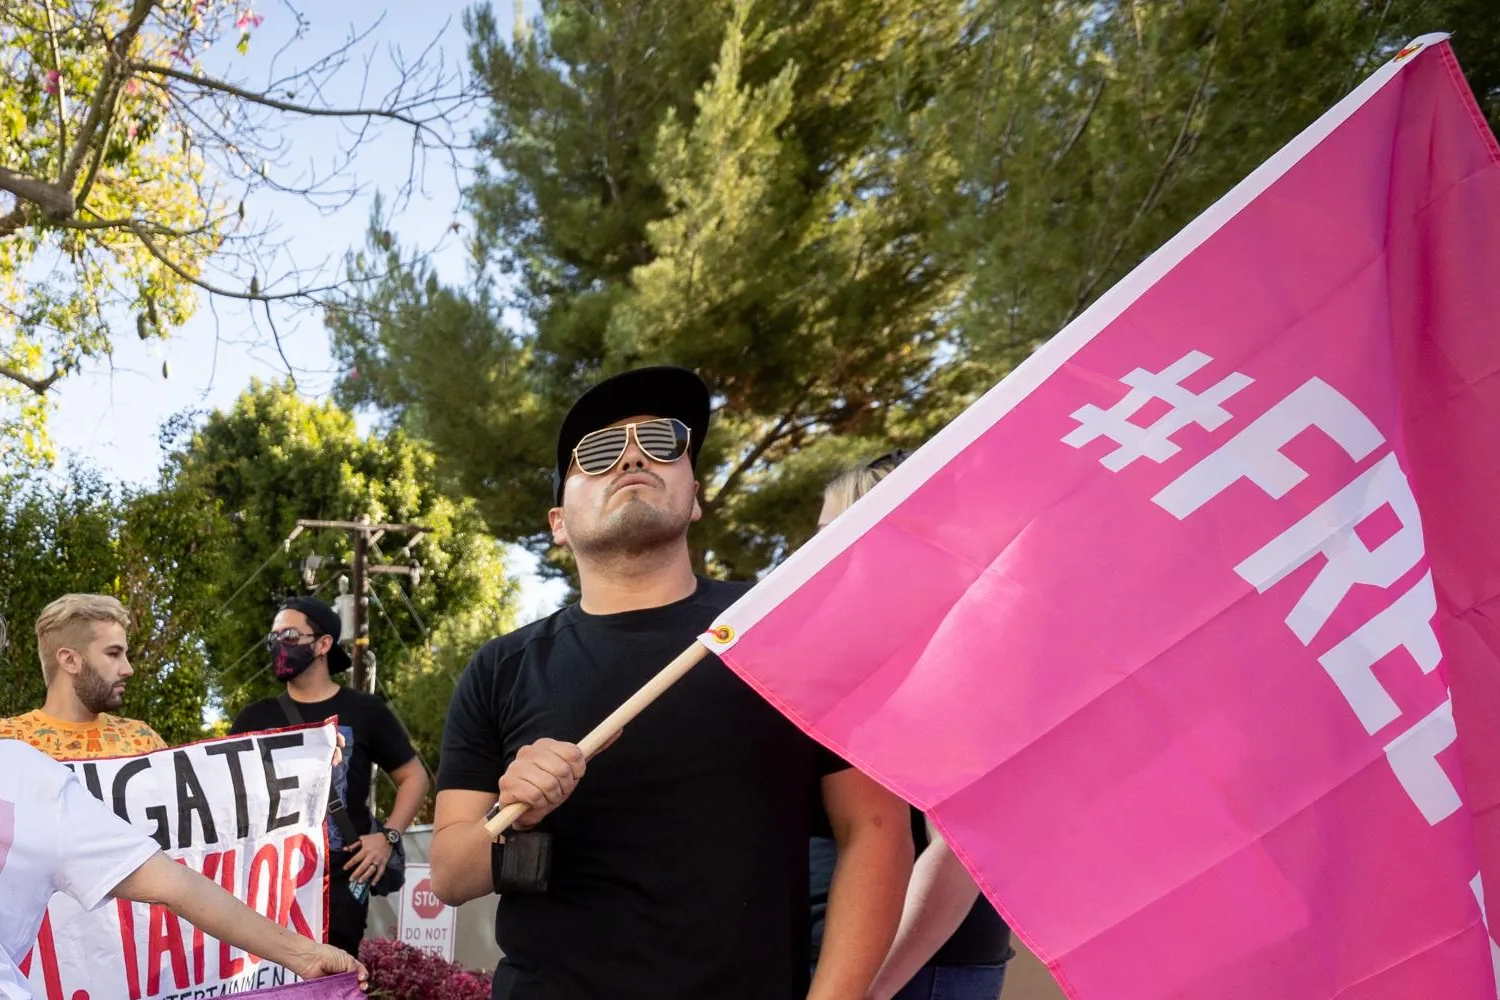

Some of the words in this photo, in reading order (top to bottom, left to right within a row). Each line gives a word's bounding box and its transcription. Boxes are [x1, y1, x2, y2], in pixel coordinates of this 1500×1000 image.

[63, 733, 304, 850] GATE
[415, 891, 440, 907] STO
[405, 927, 421, 940] DO
[425, 928, 448, 940] NOT
